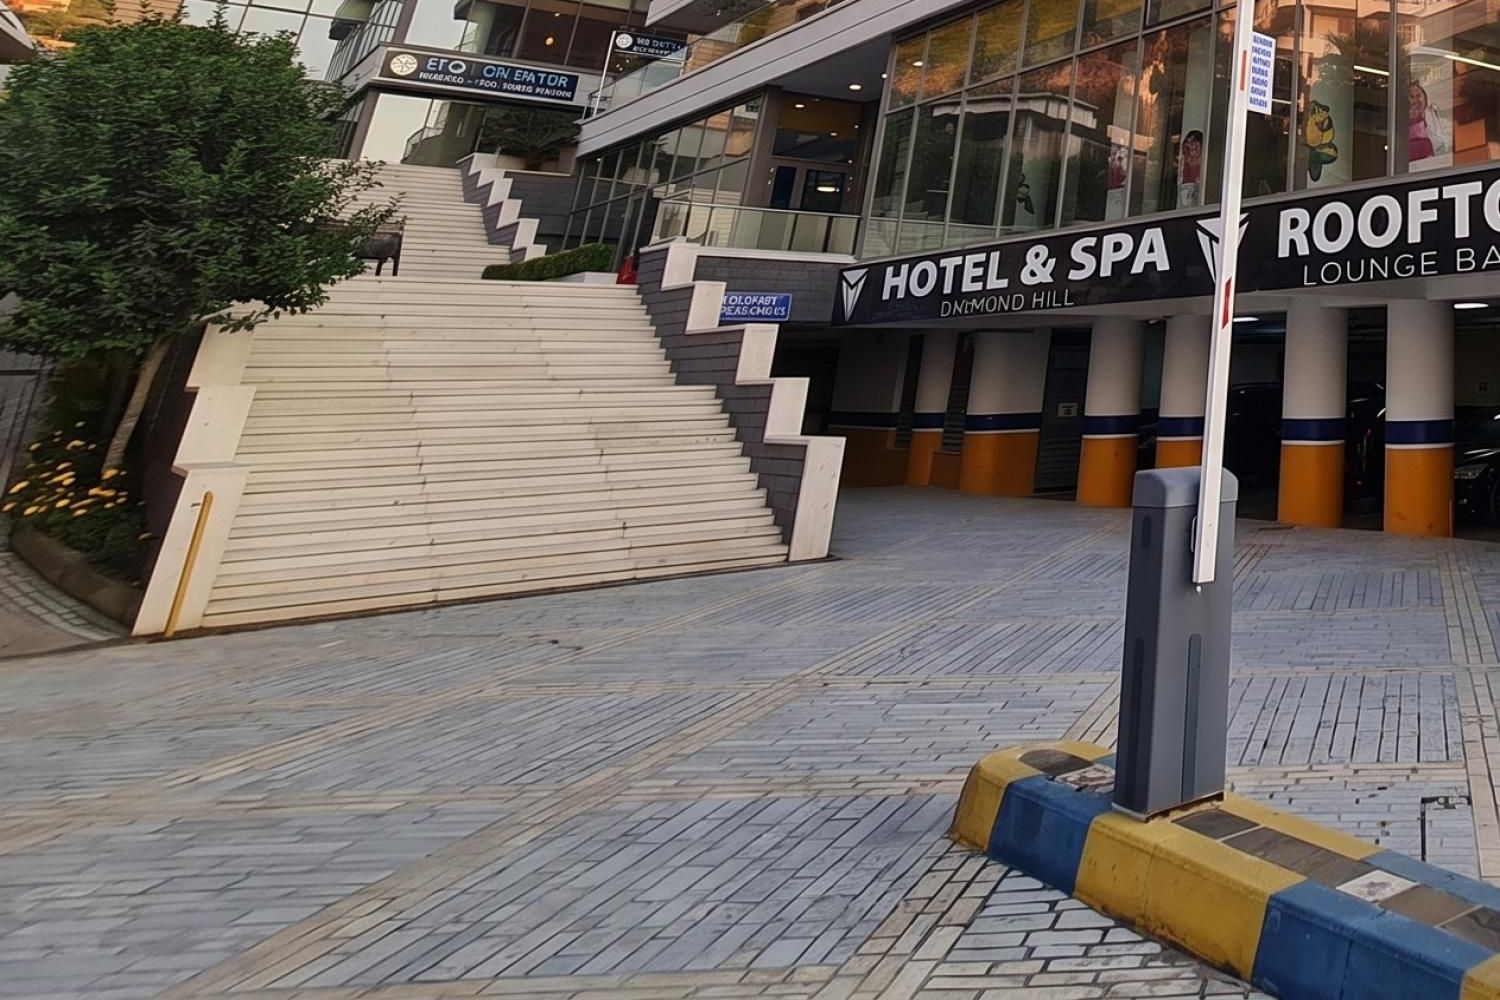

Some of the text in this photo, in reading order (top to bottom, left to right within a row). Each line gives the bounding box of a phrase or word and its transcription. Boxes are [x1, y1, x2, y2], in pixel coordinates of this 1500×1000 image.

[882, 227, 1170, 300] HOTEL & SPA
[1303, 250, 1439, 286] LOUNGE
[1031, 288, 1075, 309] HILL
